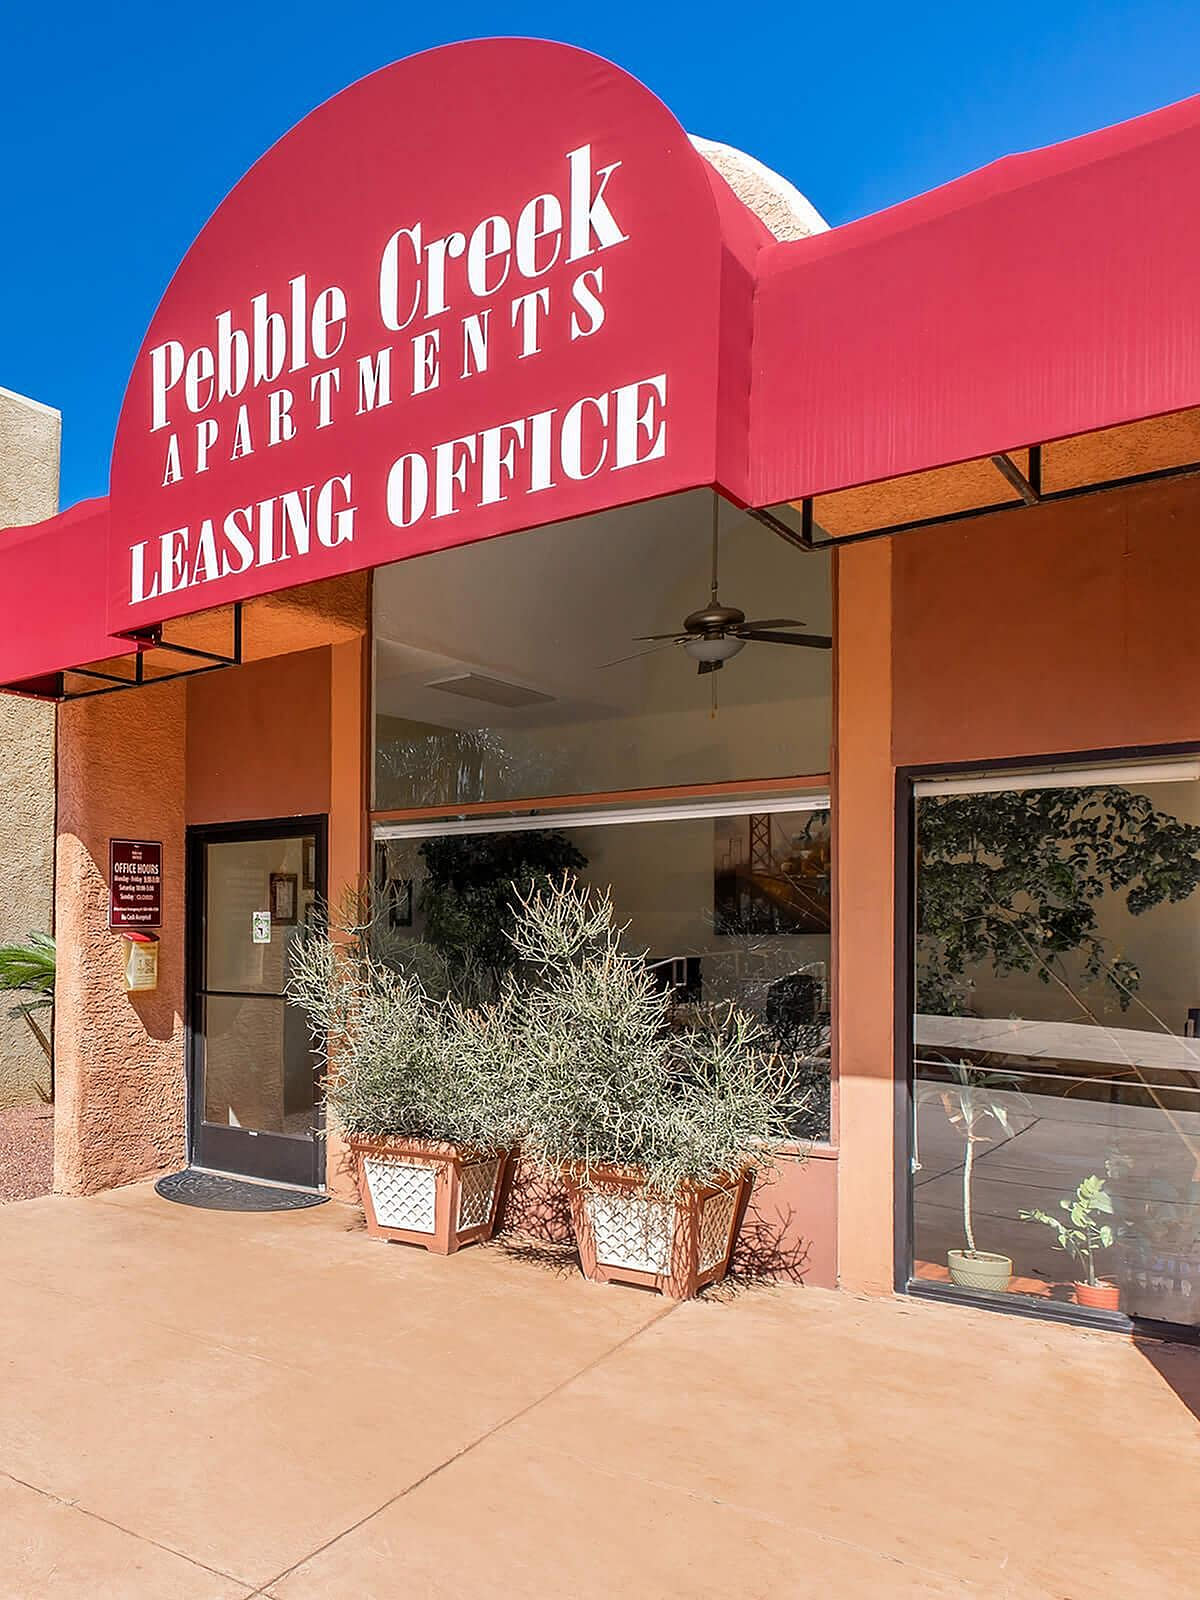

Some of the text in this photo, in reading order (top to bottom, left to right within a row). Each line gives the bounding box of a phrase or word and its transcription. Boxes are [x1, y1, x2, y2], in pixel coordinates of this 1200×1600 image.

[149, 143, 630, 433] Pebble Creek
[161, 265, 605, 487] APARTMENTS
[128, 373, 667, 605] LEASING OFFICE
[114, 862, 159, 875] OFFICE HOURS
